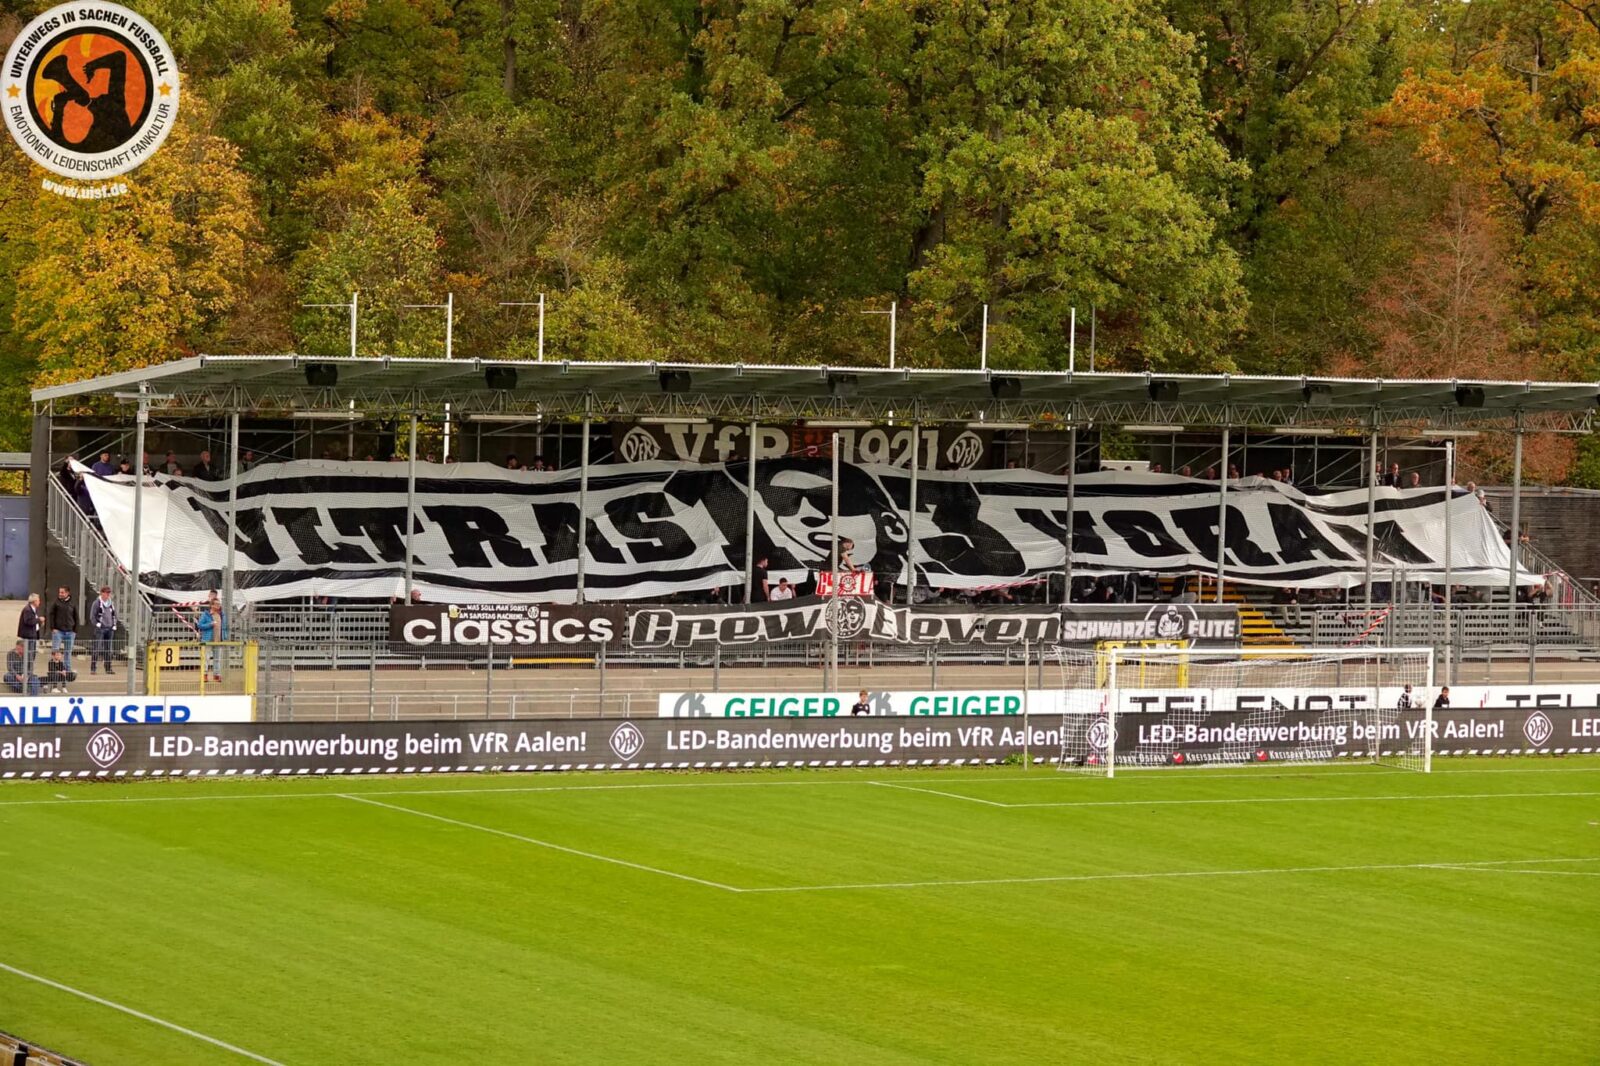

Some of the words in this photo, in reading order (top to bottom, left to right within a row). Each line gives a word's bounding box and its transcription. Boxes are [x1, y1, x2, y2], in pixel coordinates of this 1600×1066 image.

[838, 428, 939, 471] 1921
[402, 611, 614, 646] classics
[629, 607, 823, 649] Crew
[870, 599, 1061, 645] Eleven
[1063, 619, 1158, 640] SCHWARZE
[1187, 618, 1236, 639] ELITE
[165, 647, 174, 665] 8
[724, 697, 841, 717] GEIGER
[909, 695, 1021, 716] GEIGER
[666, 728, 893, 754] LED-Bandenwerbung
[900, 727, 951, 748] beim
[958, 727, 993, 747] VfR
[1000, 726, 1065, 747] Aalen!
[1138, 721, 1348, 745] LED-Bandenwerbung
[1444, 719, 1504, 739] Aalen!
[149, 734, 398, 761] LED-Bandenwerbung
[405, 732, 462, 754] beim
[469, 732, 509, 753] VfR
[515, 731, 587, 752] Aalen!
